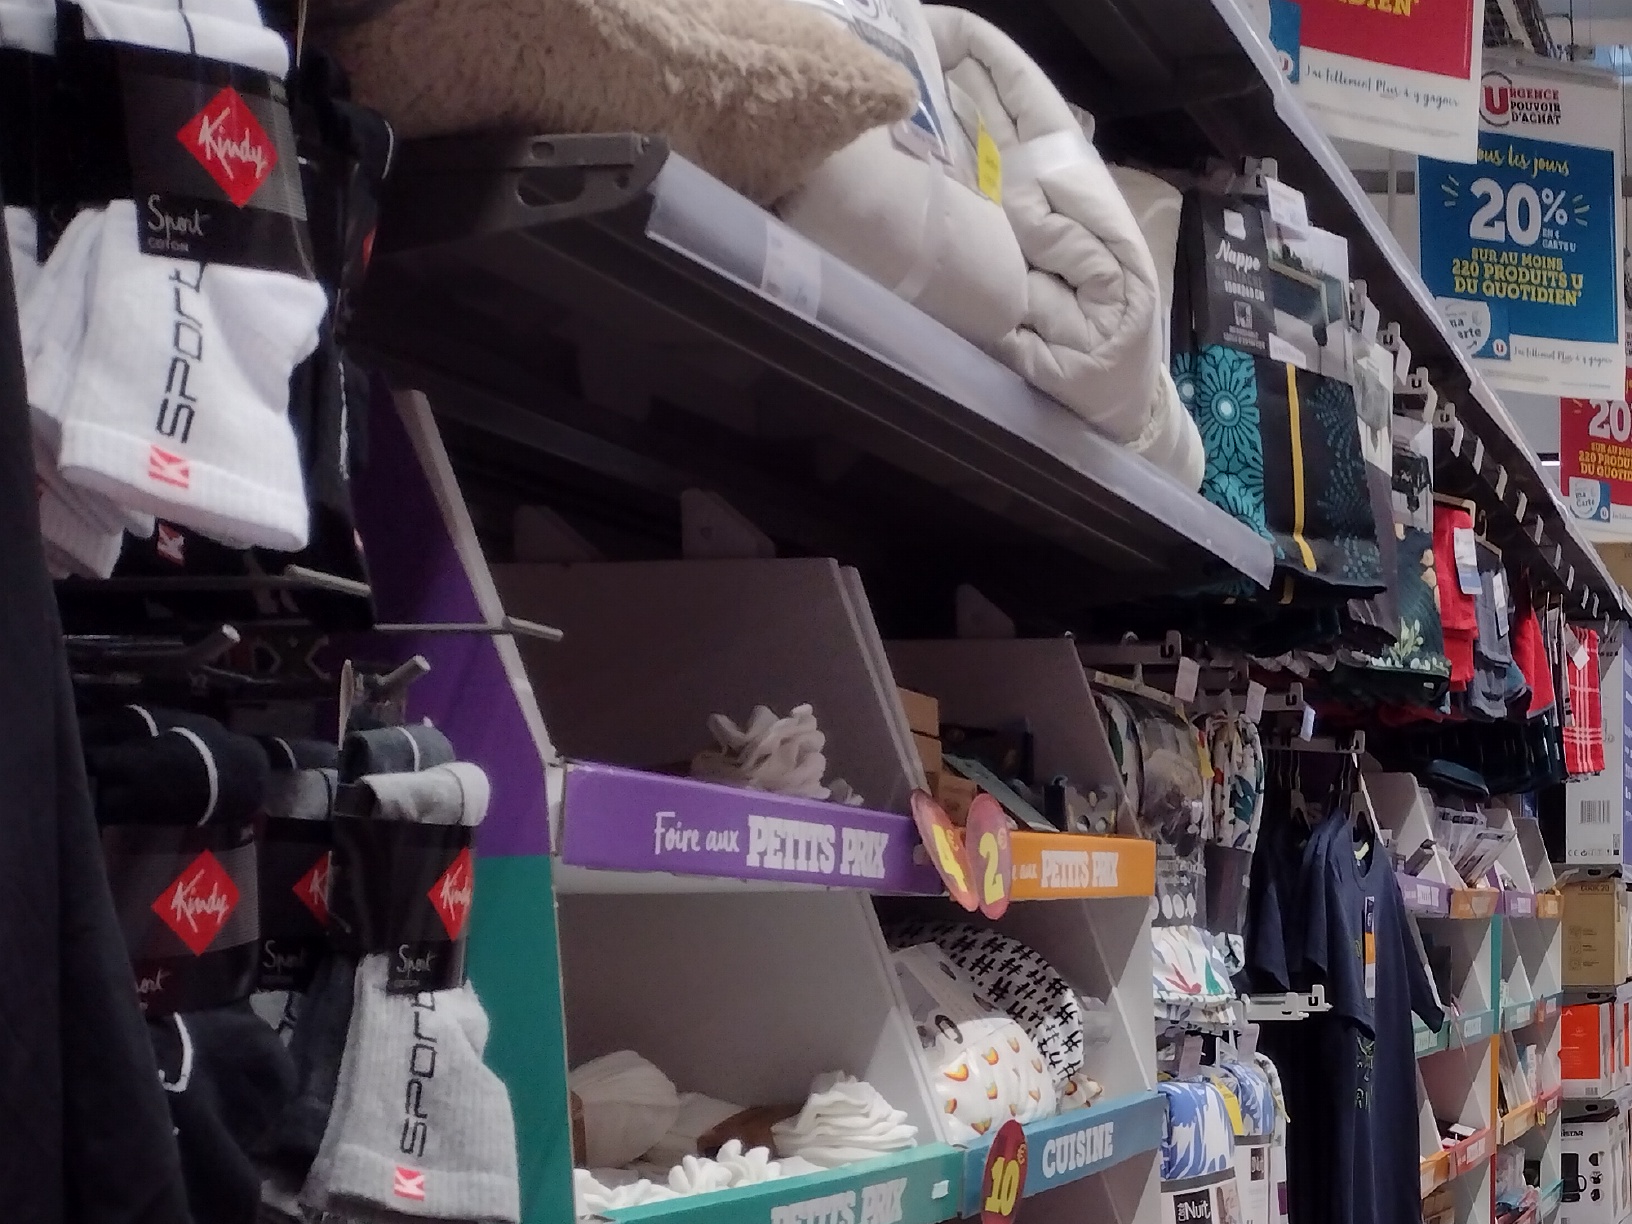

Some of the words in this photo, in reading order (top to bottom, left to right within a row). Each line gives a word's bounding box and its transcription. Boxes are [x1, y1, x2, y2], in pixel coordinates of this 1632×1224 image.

[1510, 101, 1561, 114] POUVOIR
[1511, 112, 1562, 125] D'ACHAT
[198, 106, 268, 180] Kindy
[1477, 148, 1504, 166] ous
[1508, 144, 1530, 169] les
[1531, 155, 1570, 179] jours
[147, 193, 207, 237] Sport
[1452, 258, 1480, 277] 220
[1483, 263, 1568, 289] PRODUITS
[1570, 273, 1585, 290] U
[1471, 247, 1498, 263] SUR
[1501, 250, 1519, 266] AU
[1521, 253, 1563, 271] MOINS
[1454, 277, 1479, 295] DU
[1591, 442, 1607, 453] SUR
[1608, 444, 1618, 455] AU
[1580, 462, 1595, 475] DU
[654, 811, 700, 855] Foire
[705, 829, 740, 853] aux
[746, 814, 836, 875] PETITS
[840, 827, 889, 879] PRIX
[1041, 849, 1089, 889] PETITS
[1091, 851, 1119, 888] PRIX
[170, 869, 229, 934] Kindy
[1041, 1121, 1114, 1180] CUISINE
[1186, 1199, 1211, 1221] Nuit
